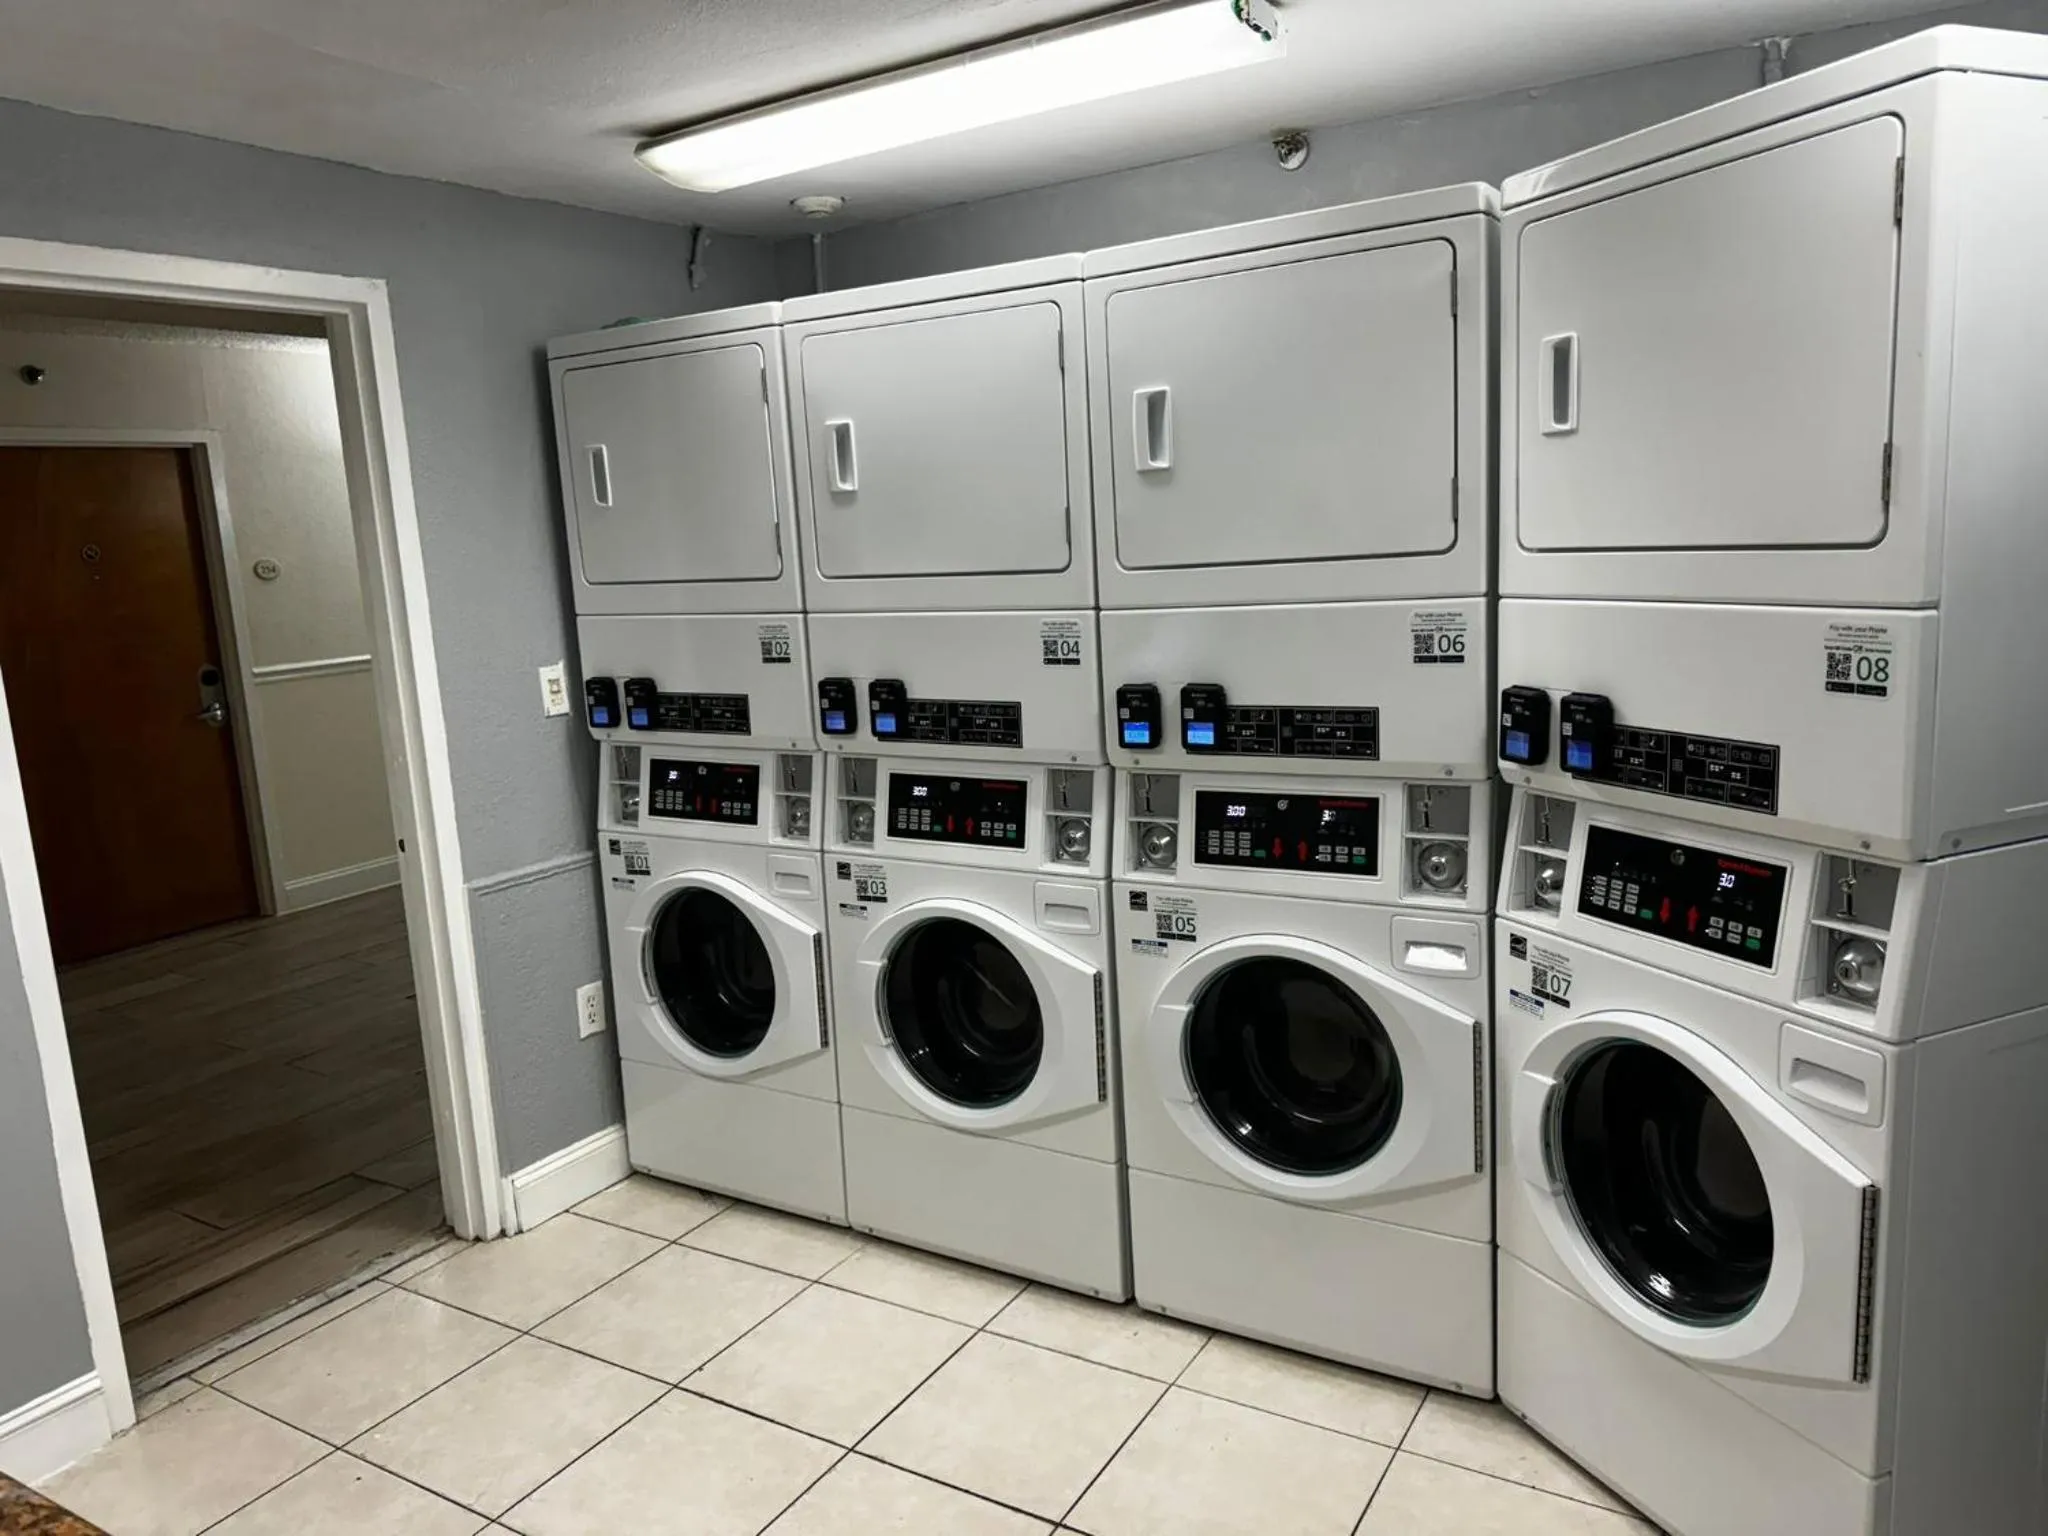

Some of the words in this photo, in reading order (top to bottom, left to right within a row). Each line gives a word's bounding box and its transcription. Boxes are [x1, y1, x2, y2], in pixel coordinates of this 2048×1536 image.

[775, 641, 791, 656] 02
[1061, 640, 1080, 656] 04
[1438, 634, 1465, 653] 06
[1856, 656, 1889, 682] 08
[636, 855, 650, 868] 01
[870, 880, 887, 895] 03
[1175, 916, 1196, 933] 05
[1551, 974, 1571, 996] 07
